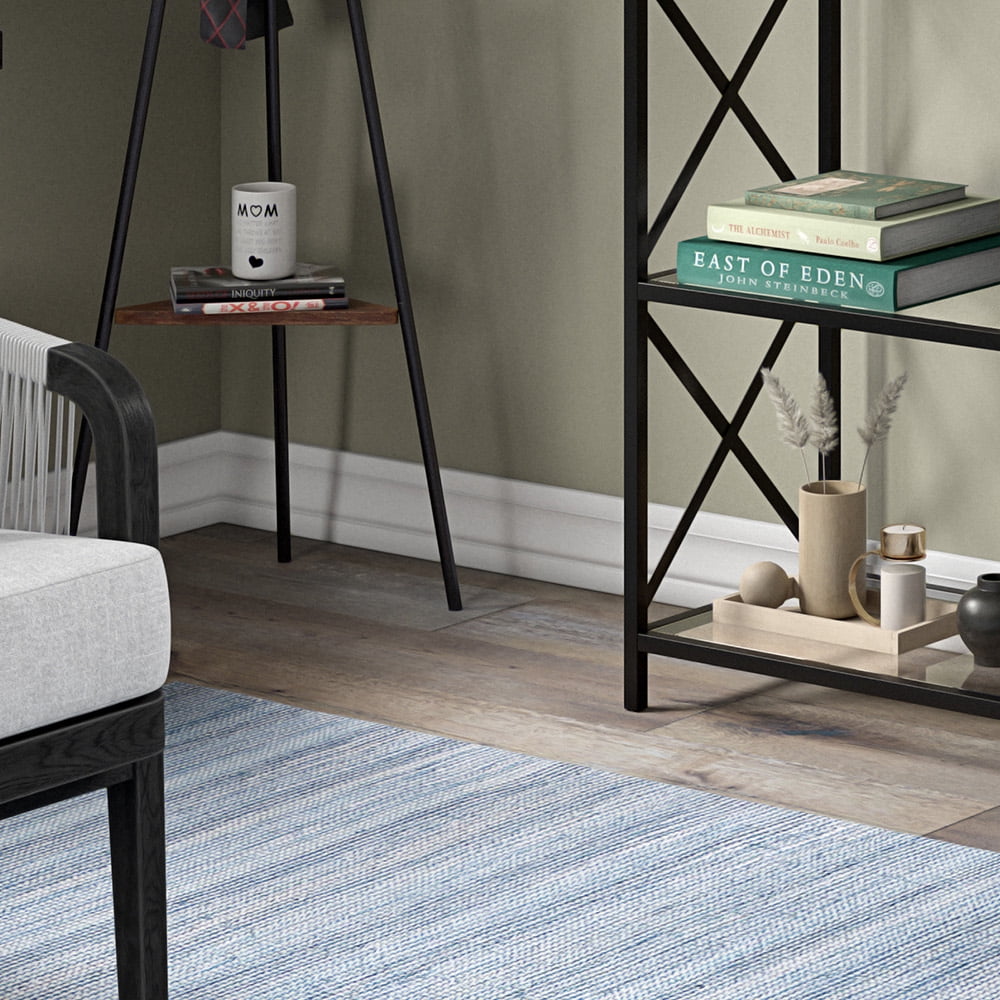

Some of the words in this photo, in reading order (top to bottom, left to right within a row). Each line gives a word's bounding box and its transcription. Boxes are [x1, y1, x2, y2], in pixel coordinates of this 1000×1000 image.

[728, 223, 745, 235] THE
[747, 226, 790, 240] ALCHEMIST
[815, 235, 835, 245] Paulo
[693, 251, 750, 273] EAST
[760, 260, 790, 279] OF
[801, 265, 865, 289] EDEN
[231, 288, 276, 299] INIQUITY
[718, 274, 758, 287] JOHN
[764, 280, 849, 299] STEINBECK
